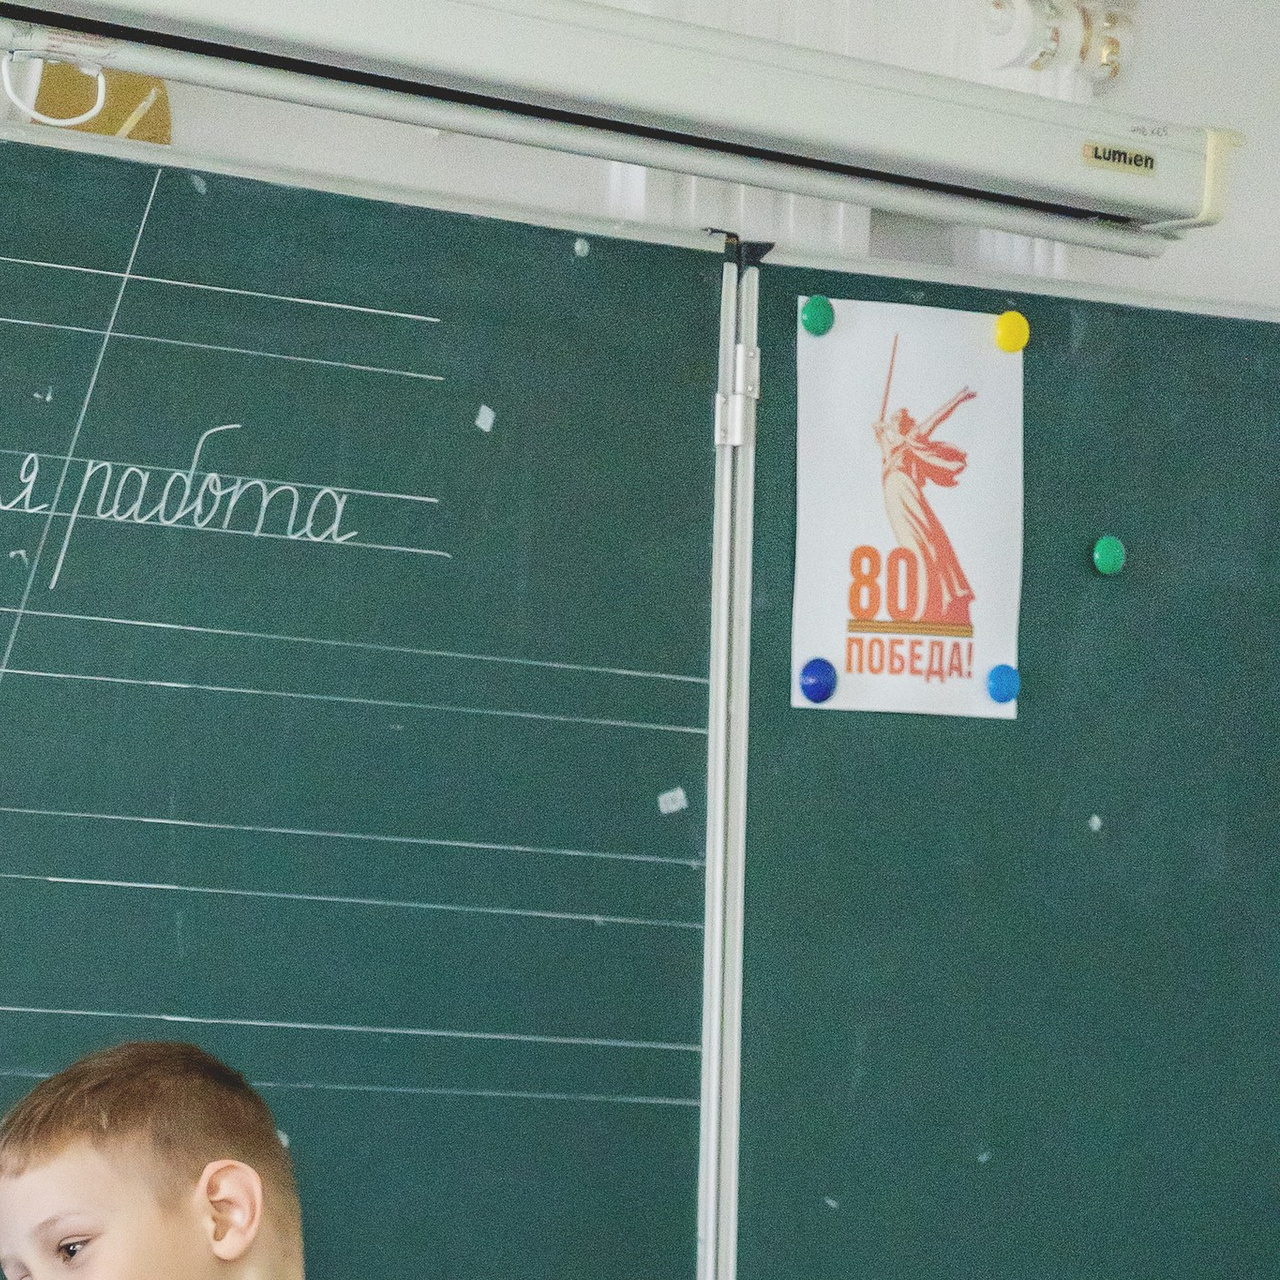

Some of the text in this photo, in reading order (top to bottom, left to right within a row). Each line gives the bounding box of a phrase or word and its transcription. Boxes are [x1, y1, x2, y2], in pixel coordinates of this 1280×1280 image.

[48, 424, 358, 590] работа
[849, 546, 919, 621] 80
[846, 637, 974, 684] ПОБЕДА!
